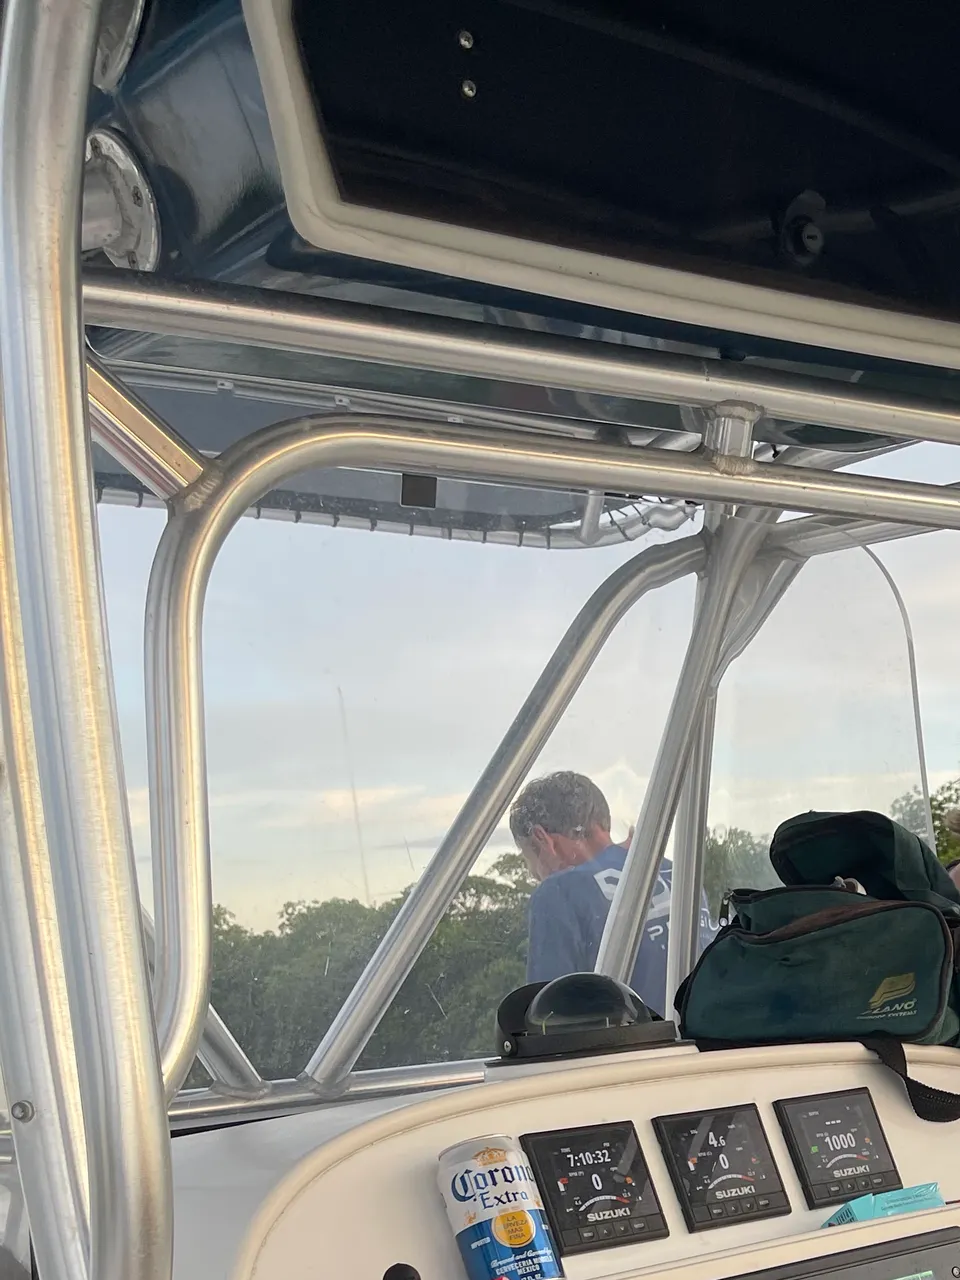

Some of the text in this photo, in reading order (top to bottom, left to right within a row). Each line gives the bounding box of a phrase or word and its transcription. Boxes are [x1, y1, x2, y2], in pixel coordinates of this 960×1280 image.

[709, 1132, 726, 1148] 4.6
[824, 1132, 856, 1151] 1000
[567, 1149, 611, 1167] 7:10:32
[719, 1153, 729, 1169] 0
[833, 1164, 870, 1178] SUZUKI
[591, 1174, 603, 1191] 0
[479, 1190, 529, 1210] Extra
[715, 1185, 755, 1200] SUZUKI
[587, 1207, 631, 1222] SUZUKI
